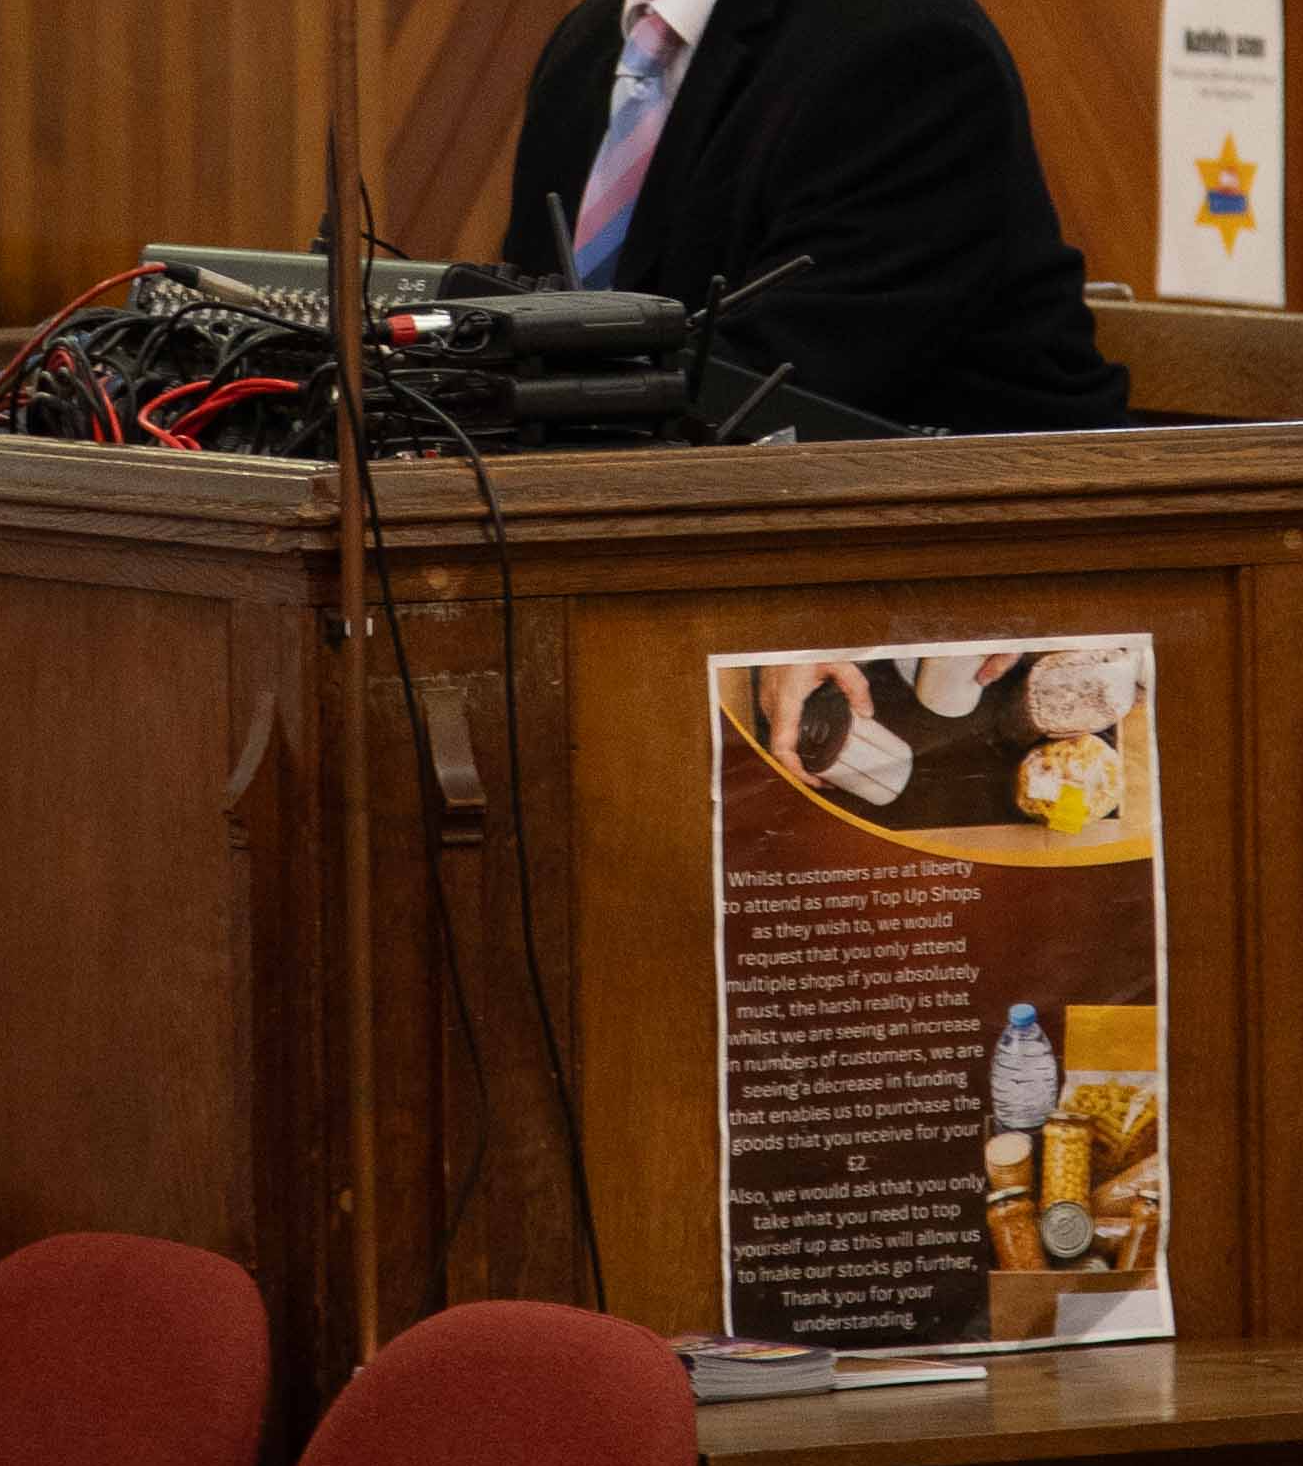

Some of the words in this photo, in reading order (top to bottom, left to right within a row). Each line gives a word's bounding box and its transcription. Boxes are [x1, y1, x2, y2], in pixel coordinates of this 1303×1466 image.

[728, 870, 783, 887] Whilst
[786, 867, 870, 885] customers
[873, 866, 898, 879] are
[900, 864, 916, 878] at
[921, 860, 973, 878] liberty
[744, 896, 801, 913] attend
[804, 896, 822, 910] as
[825, 894, 868, 911] many
[872, 890, 901, 907] Top
[904, 889, 928, 906] Up
[931, 886, 981, 903] Shops
[751, 926, 771, 939] as
[776, 922, 812, 940] they
[814, 919, 850, 935] wish
[878, 918, 902, 932] we
[905, 912, 953, 929] would
[738, 948, 803, 968] request
[806, 947, 839, 963] that
[841, 945, 871, 964] you
[874, 941, 910, 960] only
[913, 937, 966, 955] attend
[726, 975, 796, 995] multiple
[799, 972, 845, 991] shops
[847, 971, 860, 986] if
[863, 970, 892, 989] you
[894, 965, 979, 984] absolutely
[789, 1000, 816, 1017] the
[818, 998, 862, 1014] harsh
[864, 993, 916, 1012] reality
[918, 993, 931, 1007] is
[935, 992, 970, 1007] that
[728, 1029, 779, 1046] whilst
[782, 1029, 806, 1043] we
[808, 1028, 833, 1042] are
[836, 1024, 886, 1041] seeing
[889, 1022, 909, 1036] an
[912, 1018, 980, 1033] increase
[745, 1053, 818, 1071] numbers
[820, 1050, 838, 1067] of
[839, 1048, 928, 1066] customers,
[930, 1046, 954, 1059] we
[957, 1045, 984, 1058] are
[743, 1082, 799, 1100] seeing
[801, 1082, 811, 1095] a
[813, 1077, 882, 1094] decrease
[886, 1074, 902, 1088] in
[905, 1070, 967, 1088] funding
[730, 1109, 765, 1126] that
[769, 1105, 831, 1122] enables
[834, 1105, 853, 1119] us
[855, 1103, 872, 1116] to
[875, 1097, 952, 1119] purchase
[954, 1095, 980, 1111] the
[731, 1135, 784, 1155] goods
[787, 1134, 820, 1148] that
[823, 1132, 853, 1150] you
[855, 1127, 914, 1143] receive
[916, 1124, 940, 1139] for
[942, 1123, 980, 1142] your
[728, 1189, 771, 1206] Also,
[773, 1189, 796, 1203] we
[799, 1183, 850, 1200] would
[852, 1182, 878, 1198] ask
[881, 1179, 914, 1195] that
[916, 1178, 946, 1196] you
[949, 1173, 985, 1193] only
[753, 1213, 790, 1231] take
[793, 1211, 833, 1227] what
[835, 1211, 868, 1229] you
[871, 1206, 909, 1222] need
[912, 1206, 928, 1219] to
[931, 1204, 961, 1220] top
[733, 1238, 802, 1261] yourself
[805, 1239, 827, 1256] up
[829, 1238, 849, 1252] as
[852, 1234, 883, 1250] this
[885, 1232, 914, 1247] will
[916, 1229, 959, 1246] allow
[961, 1229, 980, 1242] us
[738, 1270, 756, 1284] to
[759, 1266, 802, 1282] make
[804, 1265, 833, 1278] our
[837, 1261, 889, 1278] stocks
[892, 1261, 913, 1277] go
[781, 1290, 831, 1308] Thank
[833, 1289, 866, 1308] you
[869, 1285, 895, 1302] for
[896, 1285, 934, 1303] your
